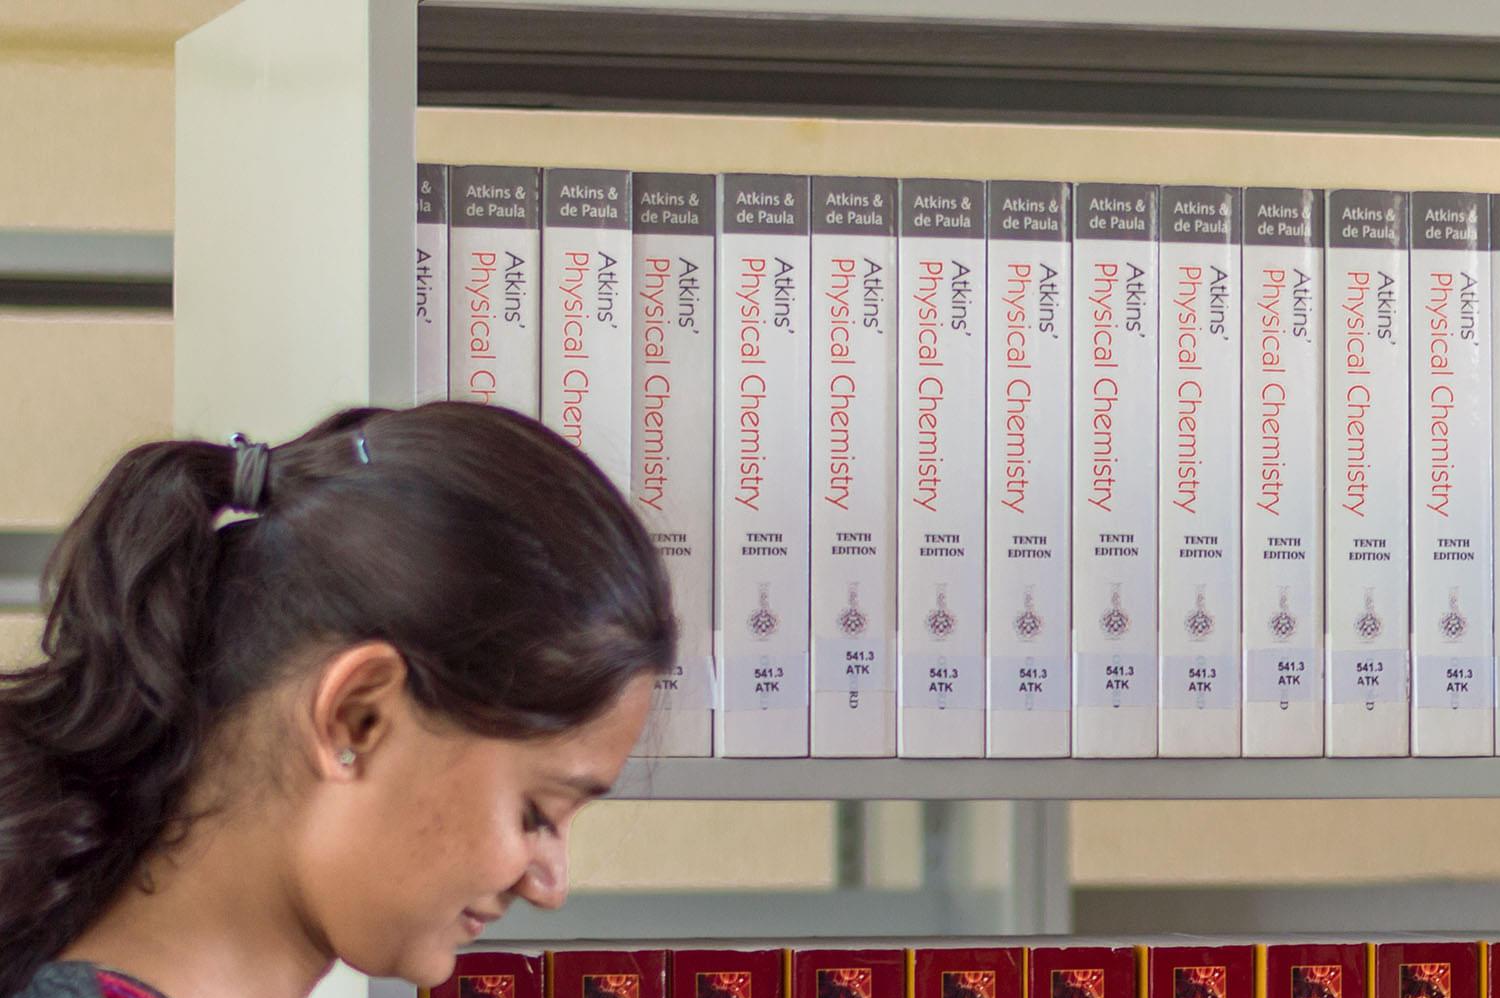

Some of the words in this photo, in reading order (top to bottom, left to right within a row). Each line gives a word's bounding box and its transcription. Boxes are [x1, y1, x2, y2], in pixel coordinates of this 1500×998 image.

[466, 185, 511, 199] Atkins
[515, 187, 527, 200] &
[560, 185, 604, 199] Atkins
[607, 186, 618, 200] &
[736, 192, 780, 205] Atkins
[784, 193, 795, 206] &
[914, 196, 957, 209] Atkins
[961, 197, 971, 210] &
[466, 204, 483, 217] de
[488, 204, 525, 218] Paula
[560, 203, 577, 216] de
[582, 204, 618, 218] Paula
[736, 210, 753, 223] de
[758, 210, 794, 224] Paula
[914, 213, 931, 227] de
[935, 214, 971, 228] Paula
[639, 257, 672, 365] Physical
[735, 257, 767, 365] Physical
[825, 258, 857, 365] Physical
[912, 261, 945, 367] Physical
[1087, 263, 1120, 368] Physical
[1172, 265, 1203, 371] Physical
[1341, 271, 1371, 375] Physical
[639, 373, 671, 511] Chemistry
[735, 373, 767, 511] Chemistry
[823, 373, 857, 511] Chemistry
[911, 376, 945, 513] Chemistry
[1087, 377, 1119, 513] Chemistry
[1172, 380, 1203, 514] Chemistry
[1341, 384, 1371, 517] Chemistry
[746, 533, 783, 543] TENTH
[836, 532, 872, 542] TENTH
[1012, 535, 1047, 545] TENTH
[1353, 538, 1386, 548] TENTH
[742, 546, 787, 556] EDITION
[831, 545, 877, 555] EDITION
[1007, 549, 1052, 559] EDITION
[1349, 552, 1390, 561] EDITION
[845, 650, 875, 662] 541.3
[754, 668, 784, 679] 541.3
[846, 664, 870, 675] ATK
[1106, 665, 1134, 676] 541.3
[1356, 662, 1383, 673] 541.3
[755, 681, 779, 692] ATK
[1106, 678, 1129, 690] ATK
[1357, 675, 1379, 686] ATK
